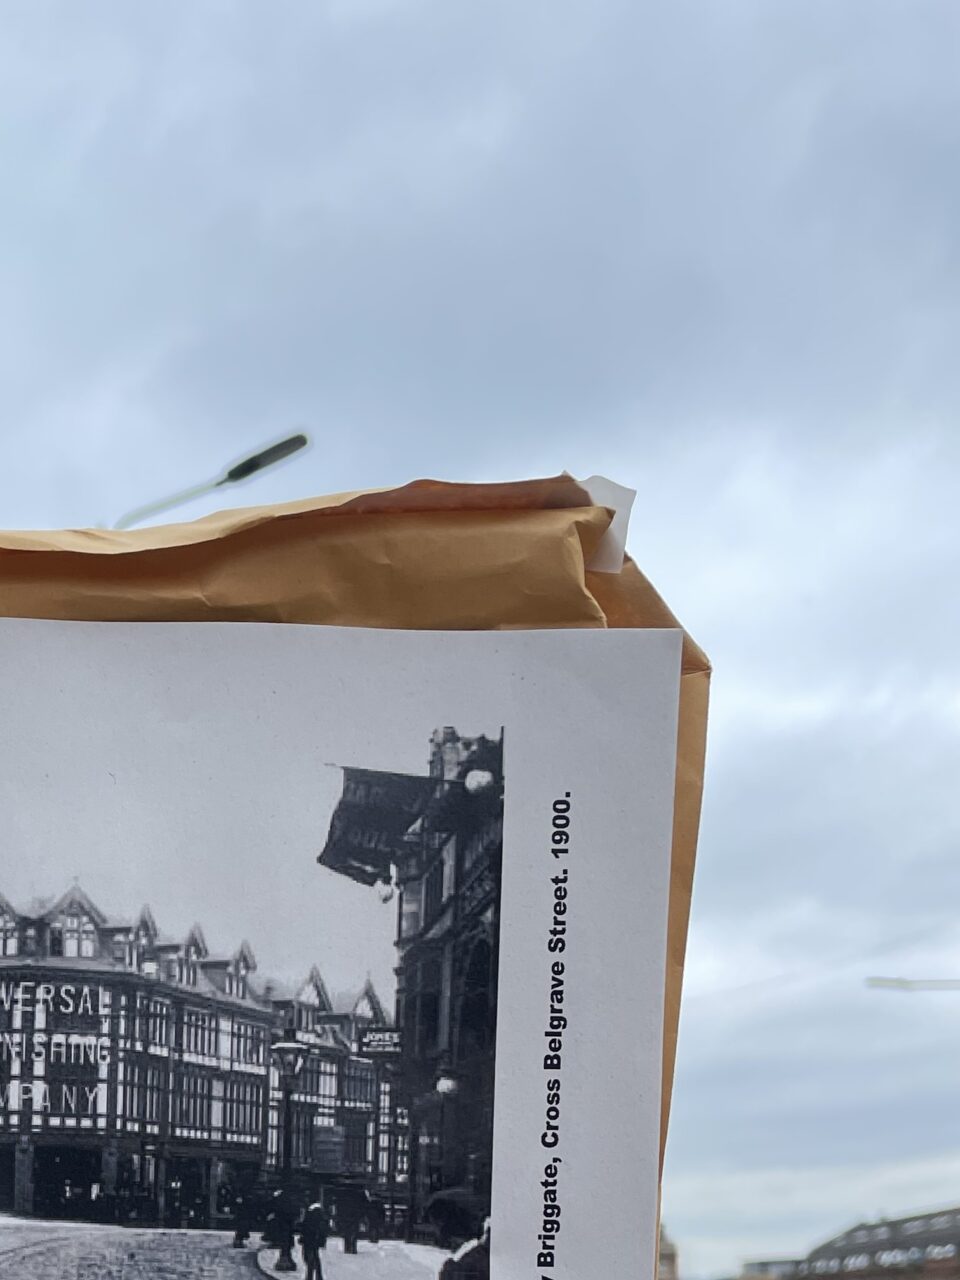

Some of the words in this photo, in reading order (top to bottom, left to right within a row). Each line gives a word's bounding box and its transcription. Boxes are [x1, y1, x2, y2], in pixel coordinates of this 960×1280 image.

[551, 791, 571, 859] 1900.
[548, 868, 568, 954] Street.
[544, 961, 568, 1070] Belgrave
[541, 1078, 561, 1149] Cross
[537, 1157, 562, 1268] Briggate,
